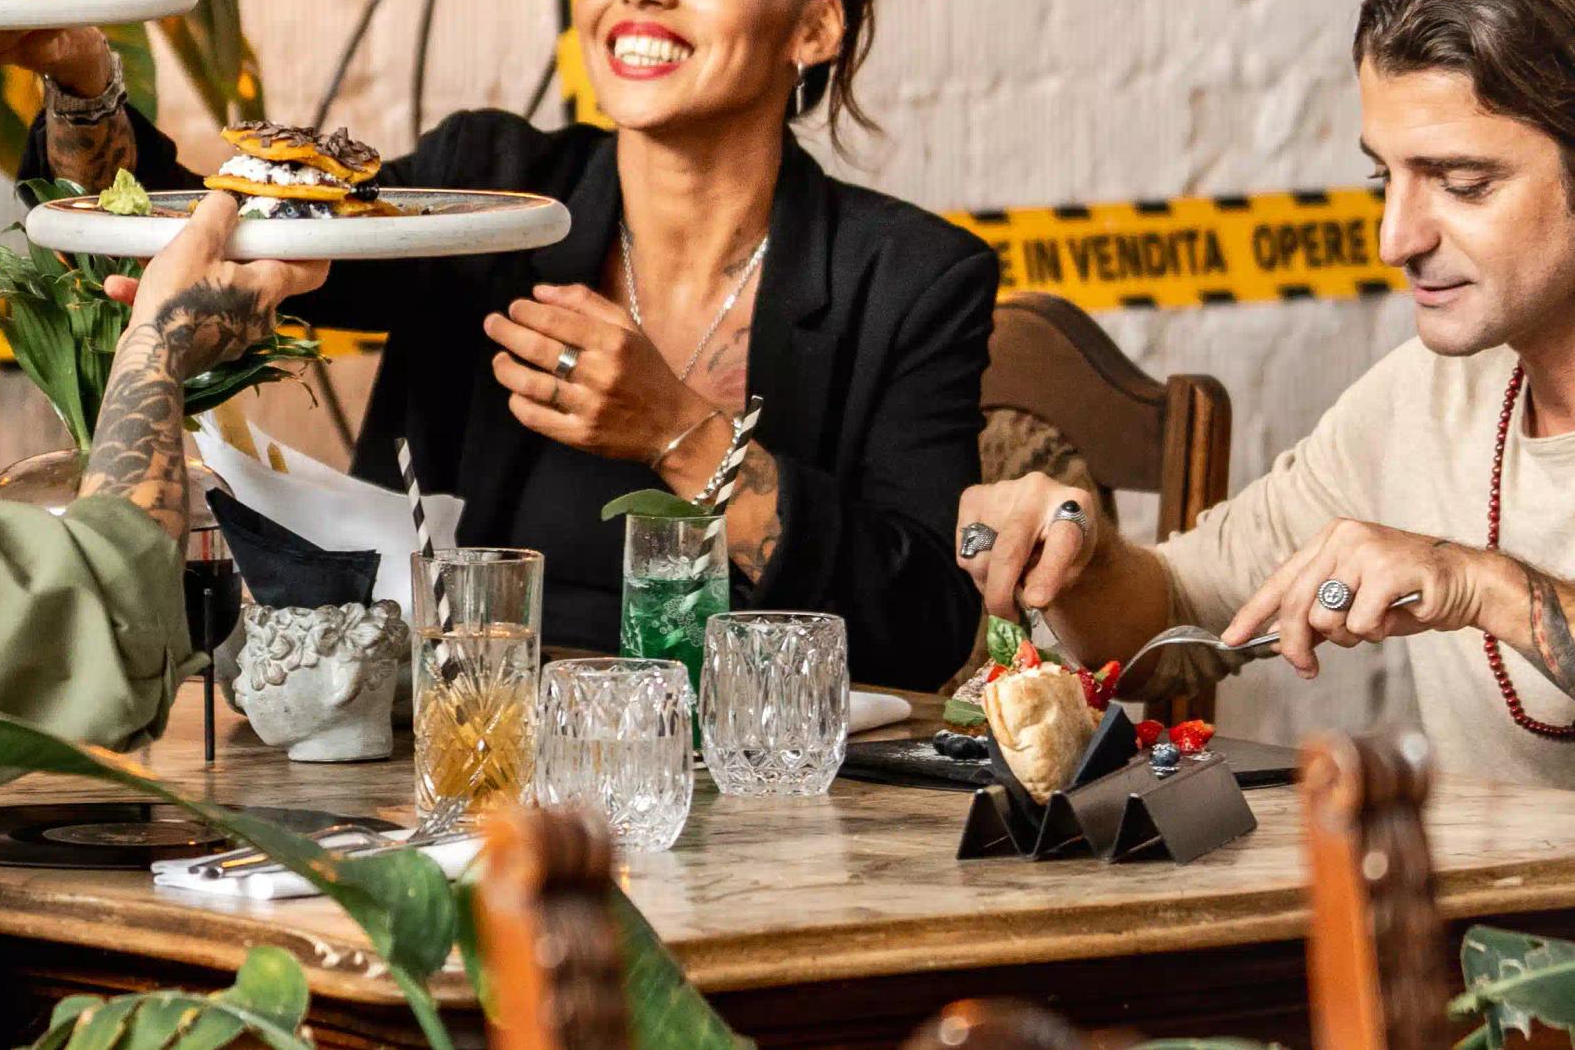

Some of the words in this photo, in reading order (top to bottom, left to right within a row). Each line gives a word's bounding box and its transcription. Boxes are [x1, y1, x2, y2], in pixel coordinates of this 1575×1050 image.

[1023, 238, 1062, 284] IN
[1066, 228, 1227, 282] VENDITA
[1253, 218, 1369, 272] OPERE
